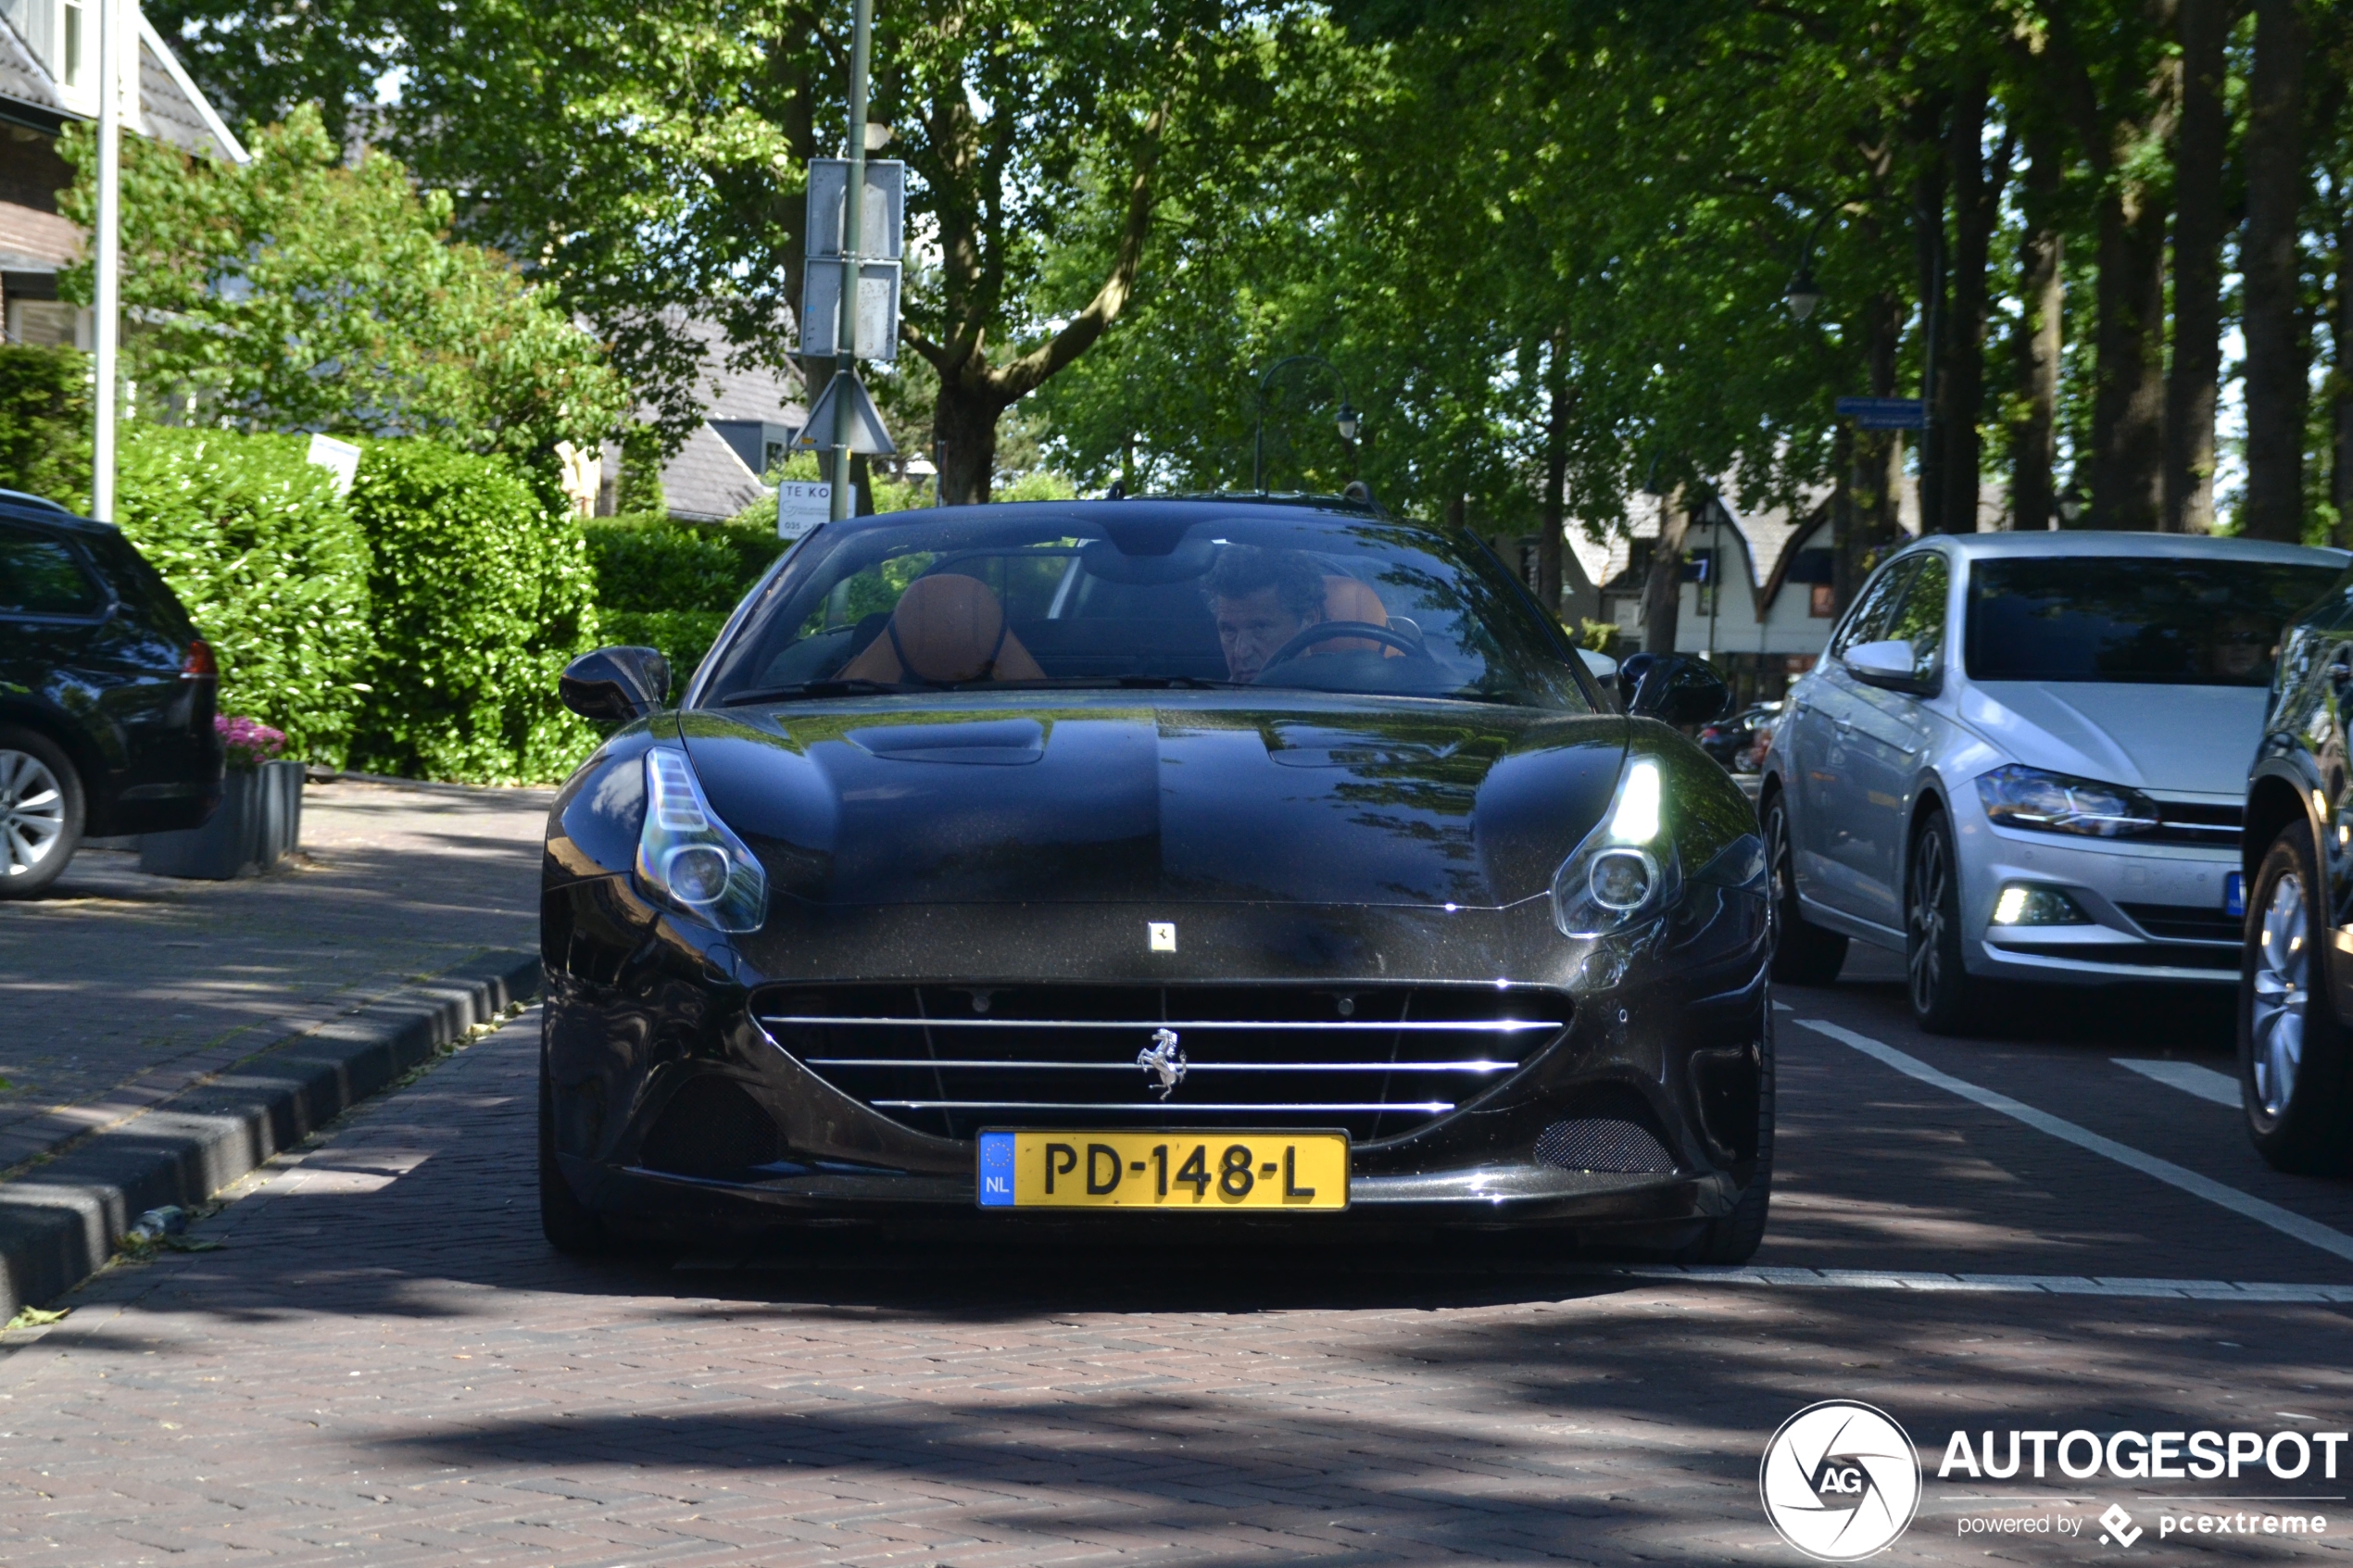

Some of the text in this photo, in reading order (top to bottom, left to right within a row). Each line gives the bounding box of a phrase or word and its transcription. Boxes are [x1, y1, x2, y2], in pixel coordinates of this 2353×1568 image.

[786, 485, 830, 498] TE KO
[1045, 1143, 1315, 1197] PD-148-L
[986, 1176, 1010, 1193] NL
